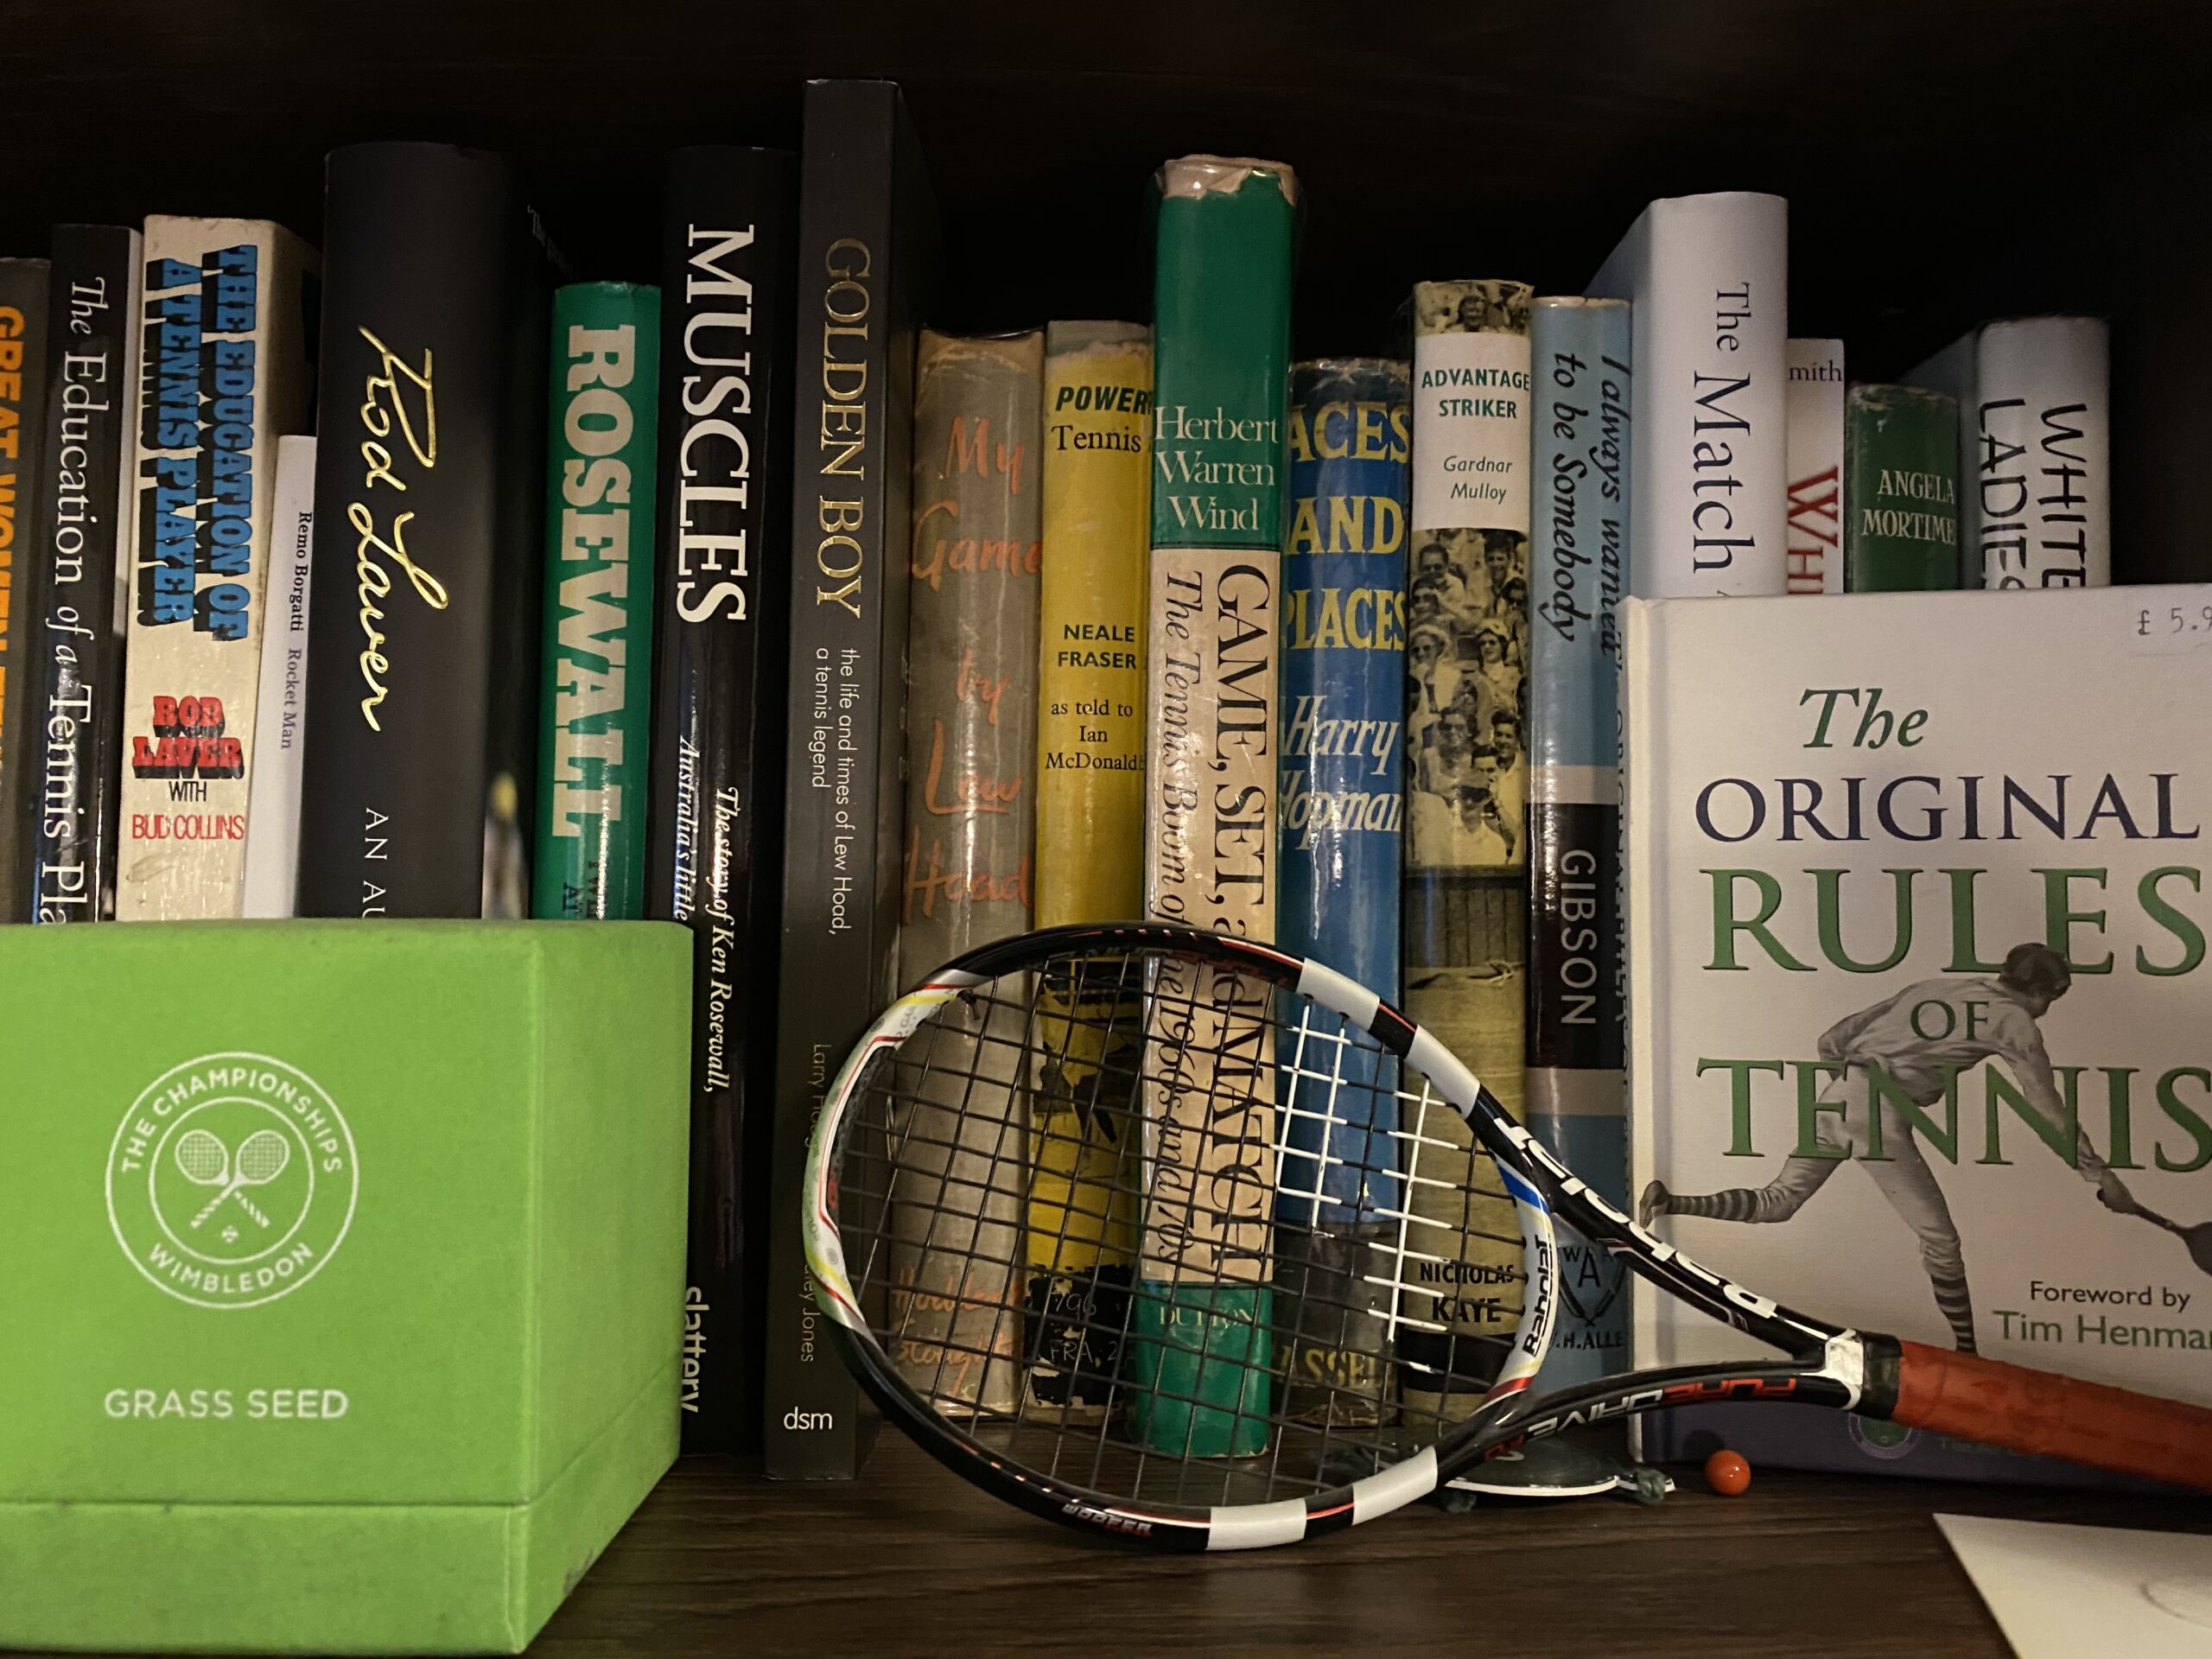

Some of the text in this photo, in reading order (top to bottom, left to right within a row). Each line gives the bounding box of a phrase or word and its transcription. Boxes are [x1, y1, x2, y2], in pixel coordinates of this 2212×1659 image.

[71, 276, 110, 335] The
[1715, 282, 1752, 353] The
[1421, 368, 1530, 391] ADVANTAGE
[1601, 354, 1632, 375] I
[676, 223, 755, 623] MUSCLES
[816, 238, 872, 620] GOLDEN BOY
[1055, 385, 1149, 416] POWER
[1154, 405, 1281, 444] Herbert
[1438, 398, 1517, 419] STRIKER
[143, 257, 202, 626] A TENNIS PLAYER
[200, 244, 258, 641] THE EDUCATION OF
[944, 414, 1025, 496] My
[1051, 423, 1142, 453] Tennis
[1443, 454, 1513, 474] Gardnar
[1588, 378, 1632, 503] always
[55, 351, 110, 586] Education
[1154, 450, 1276, 486] Warren
[1450, 482, 1507, 505] Mulloy
[1537, 351, 1593, 643] to be Somebody
[1692, 370, 1756, 575] Match
[1877, 469, 1956, 505] ANGELA
[2037, 403, 2088, 588] WHITE
[347, 324, 449, 733] Rod Laver
[1167, 495, 1260, 531] Wind
[1286, 495, 1405, 555] AND
[912, 499, 1043, 594] Game
[551, 324, 636, 837] ROSEWALL
[1166, 570, 1203, 641] The
[46, 606, 94, 640] of
[280, 512, 313, 750] Remo Borgatti Rocket Man
[1063, 624, 1135, 642] NEALE
[2138, 609, 2151, 636] £
[54, 644, 79, 664] a
[1058, 651, 1137, 670] FRASER
[1207, 564, 1270, 772] GAME,
[957, 646, 1011, 725] by
[1051, 701, 1135, 717] as told to
[1162, 652, 1201, 768] Tennis
[808, 647, 833, 788] a tennis legend
[1078, 726, 1109, 743] Ian
[1281, 695, 1402, 776] Harry
[1798, 687, 1929, 749] The
[43, 683, 92, 840] Tennis
[132, 735, 245, 779] LAVER
[925, 718, 1024, 817] Lew
[1046, 753, 1137, 772] McDonald
[168, 781, 207, 802] WITH
[715, 785, 741, 832] The
[829, 647, 861, 935] the life and times of Lew Hoad,
[1694, 772, 2201, 843] ORIGINAL
[131, 814, 245, 840] BUD COLLINS
[364, 807, 390, 861] AN
[674, 734, 701, 922] Australia's little
[1160, 782, 1198, 886] Boom
[1205, 784, 1268, 906] SET,
[904, 823, 1032, 926] Hoad
[704, 899, 735, 926] of
[1560, 849, 1598, 1025] GIBSON
[1699, 865, 2207, 976] RULES
[711, 925, 735, 974] Ken
[702, 978, 733, 1093] Rosewall,
[1909, 999, 1990, 1041] OF
[806, 1044, 832, 1089] Larry
[121, 1066, 343, 1173] THE CHAMPIONSHIPS
[1211, 1020, 1266, 1268] MATCH
[1696, 1056, 2212, 1173] TENNIS
[149, 1242, 315, 1294] WIMBLEDON
[1419, 1262, 1514, 1285] NICHOLAS
[2030, 1280, 2191, 1314] Foreword by
[800, 1307, 822, 1363] Jones
[1432, 1296, 1502, 1324] KAYE
[1992, 1309, 2212, 1350] Tim Henma
[104, 1388, 349, 1420] GRASS SEED
[783, 1406, 833, 1431] dsm
